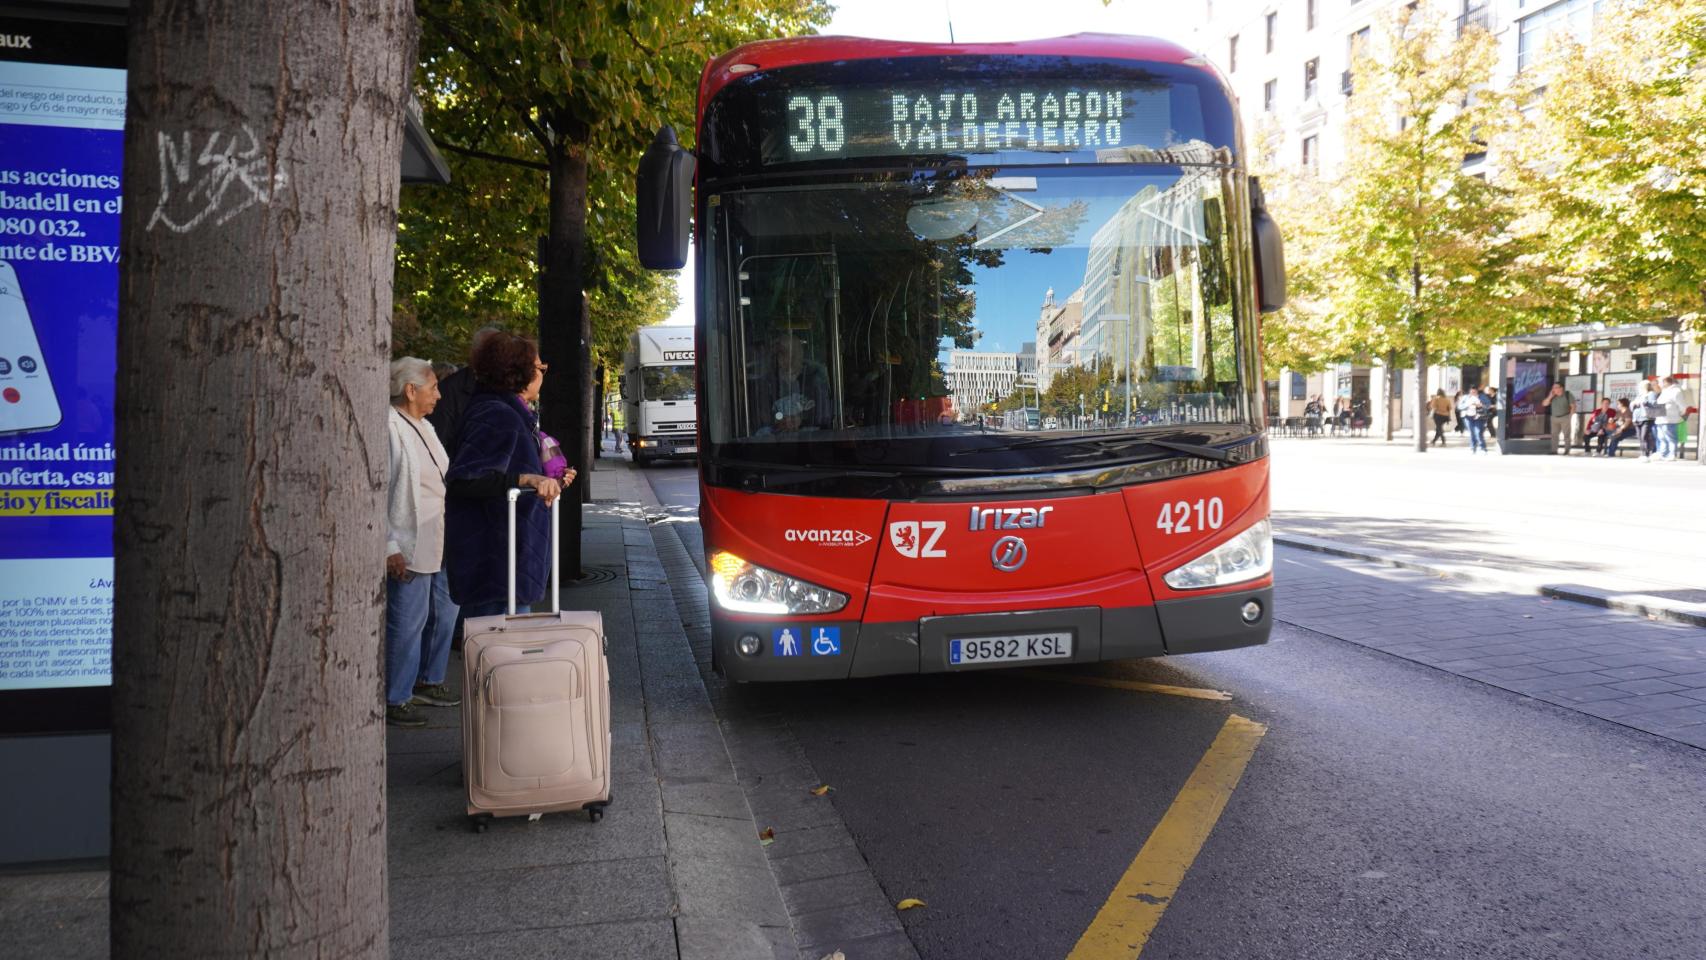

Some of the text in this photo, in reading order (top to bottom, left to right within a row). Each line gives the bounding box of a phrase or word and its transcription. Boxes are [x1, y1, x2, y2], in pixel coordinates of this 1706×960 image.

[66, 105, 99, 117] mayor
[892, 90, 1123, 122] BAJO ARAGON
[788, 96, 845, 152] 38
[893, 119, 1122, 149] VALDEFIERRO
[23, 168, 120, 189] acciones
[73, 198, 101, 213] en
[103, 195, 122, 214] el
[38, 218, 87, 238] 032.
[38, 242, 67, 261] de
[69, 244, 121, 263] BBV
[0, 442, 71, 461] nidad
[71, 471, 96, 486] es
[27, 496, 42, 514] y
[1156, 496, 1224, 535] 4210
[784, 528, 854, 543] avanza
[2, 599, 20, 609] por
[34, 596, 68, 607] CNMV
[81, 595, 88, 605] 5
[90, 596, 104, 605] de
[15, 607, 45, 617] 100%
[19, 629, 32, 638] de
[49, 627, 94, 636] derechos
[95, 627, 108, 635] de
[965, 636, 1067, 660] 9582 KSL
[13, 660, 32, 668] con
[34, 659, 48, 667] un
[9, 669, 34, 678] cada
